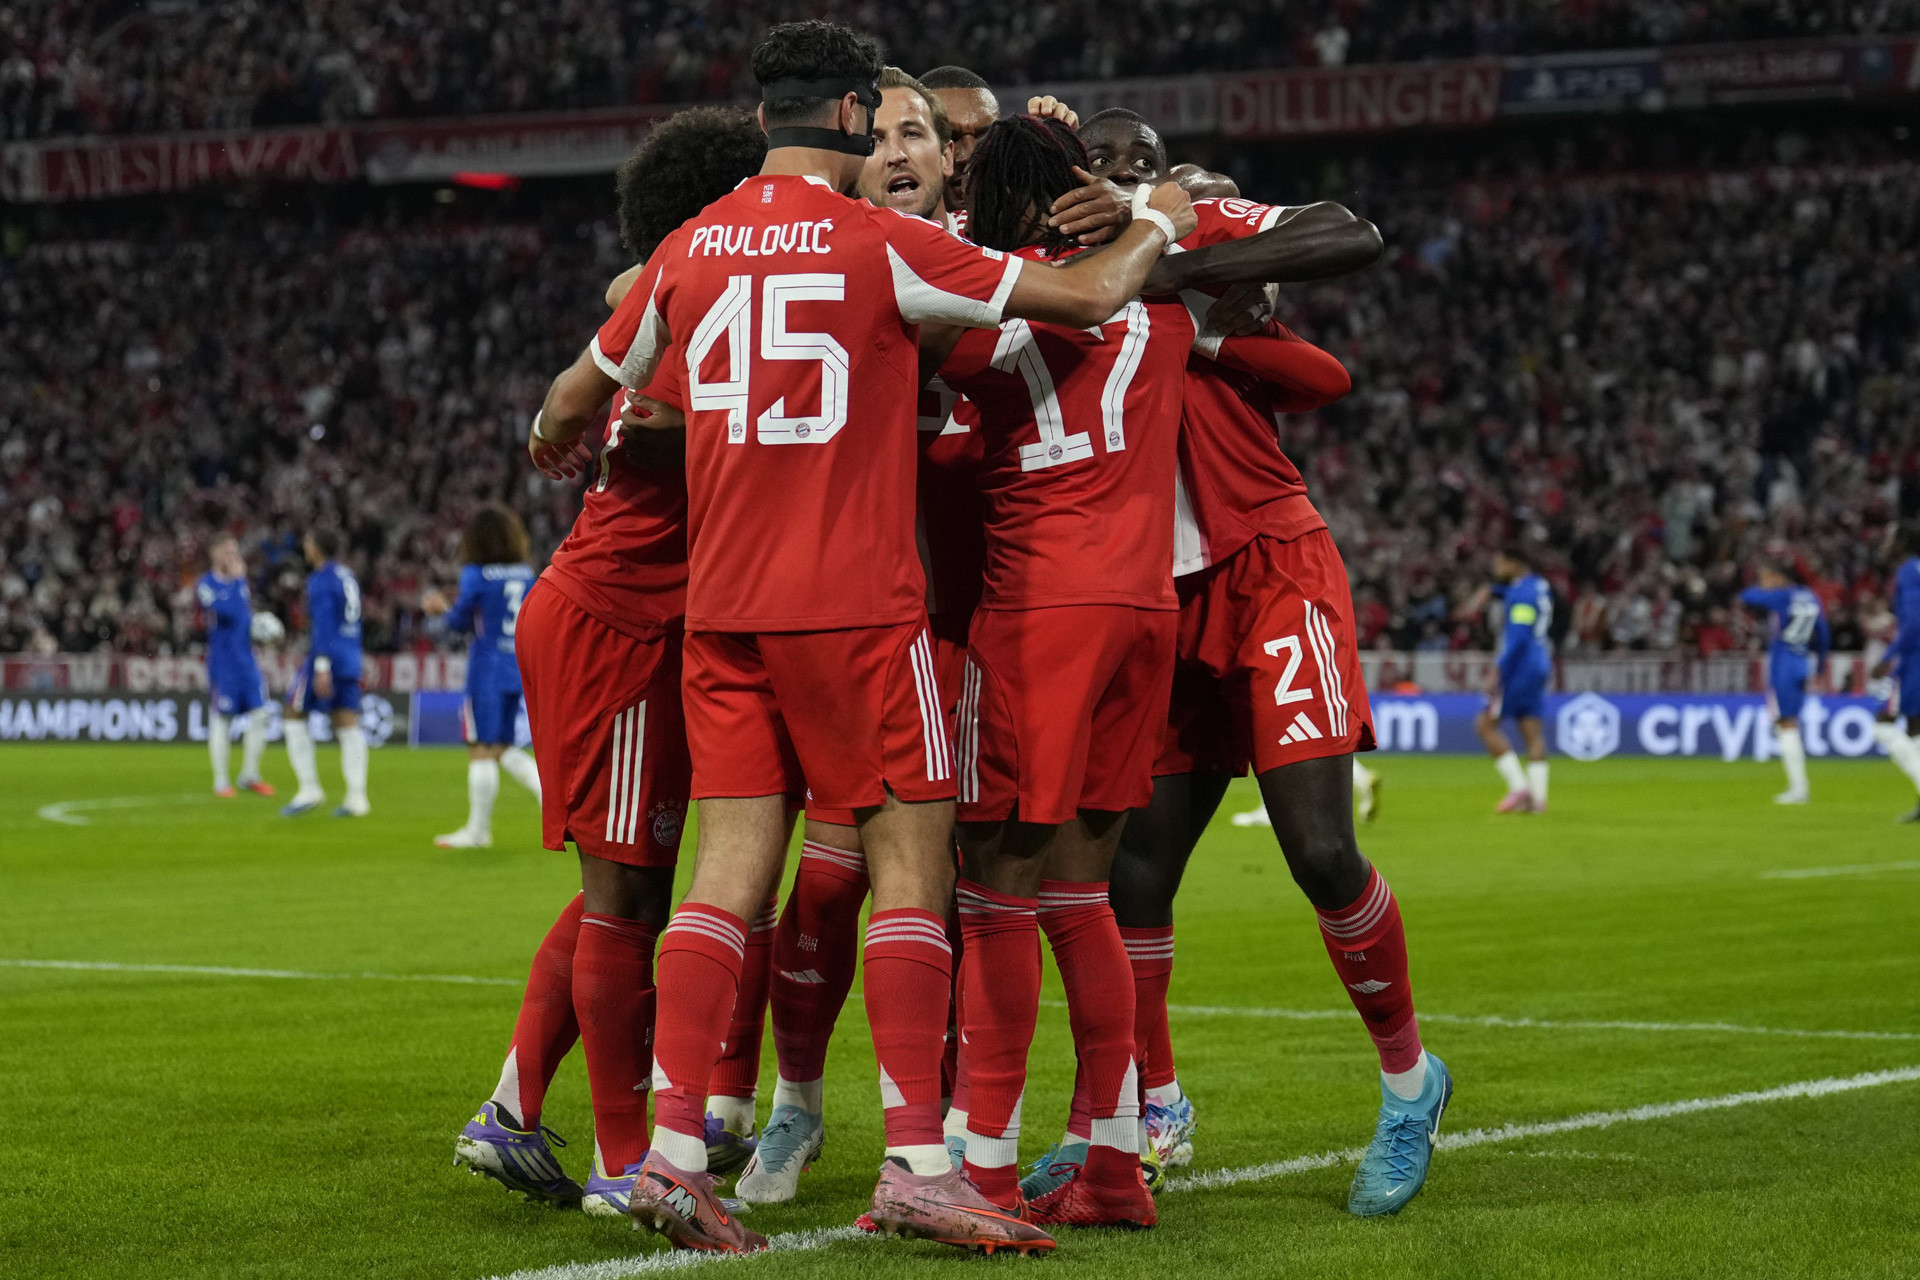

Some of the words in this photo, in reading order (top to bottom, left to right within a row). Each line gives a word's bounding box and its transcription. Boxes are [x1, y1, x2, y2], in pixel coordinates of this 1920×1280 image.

[1219, 65, 1499, 135] DILLINGEN
[688, 218, 835, 258] PAVLOVIĆ
[686, 273, 849, 445] 45
[990, 295, 1151, 473] 17
[503, 580, 526, 637] 3
[1783, 601, 1820, 645] 27
[1263, 634, 1314, 706] 2
